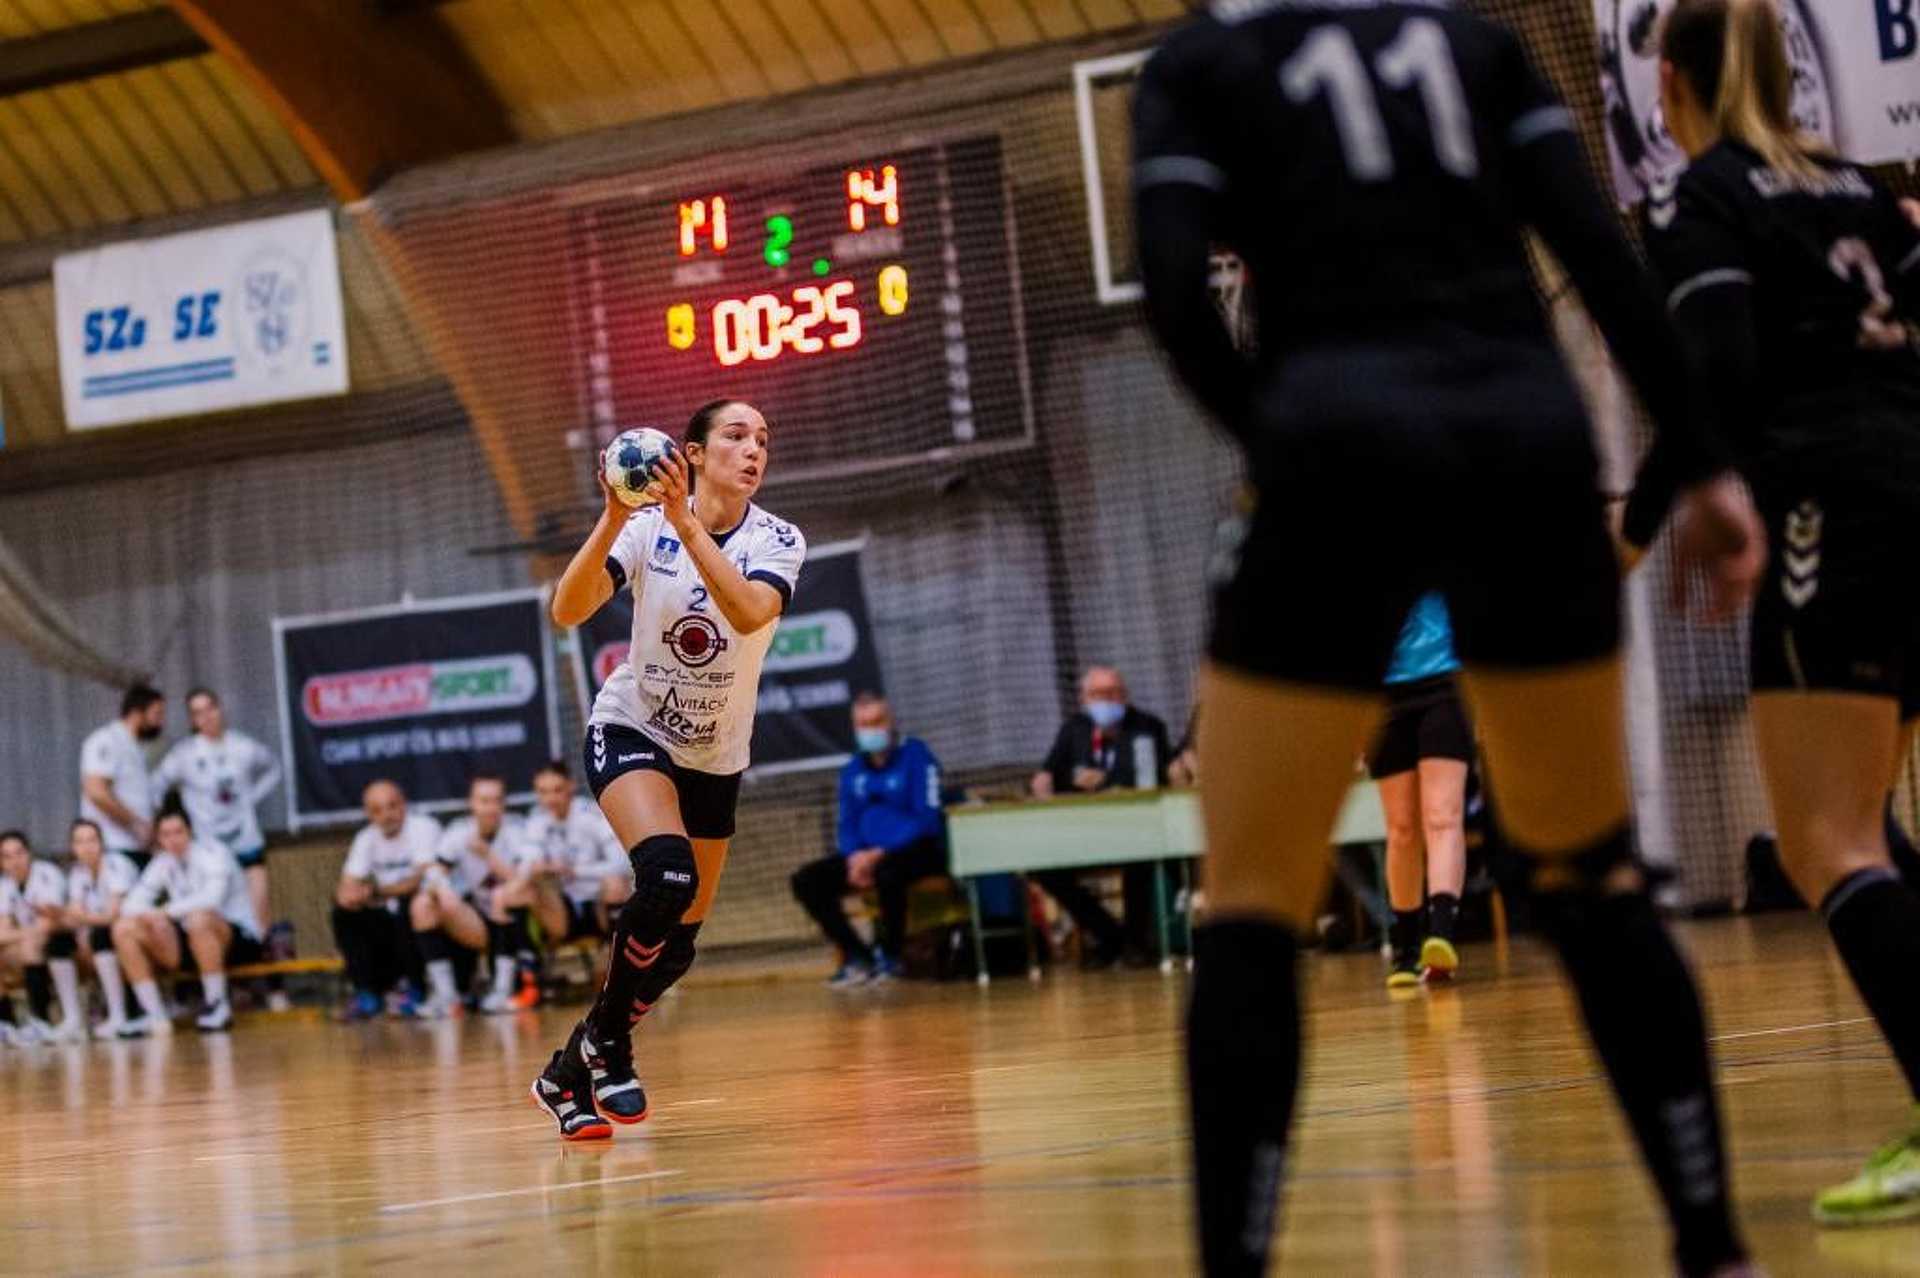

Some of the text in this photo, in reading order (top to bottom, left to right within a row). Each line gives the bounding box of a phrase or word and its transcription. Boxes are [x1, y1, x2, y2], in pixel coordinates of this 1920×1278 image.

[1280, 22, 1479, 182] 11
[173, 291, 221, 341] SE
[712, 280, 862, 367] 00:25
[688, 586, 708, 612] 2
